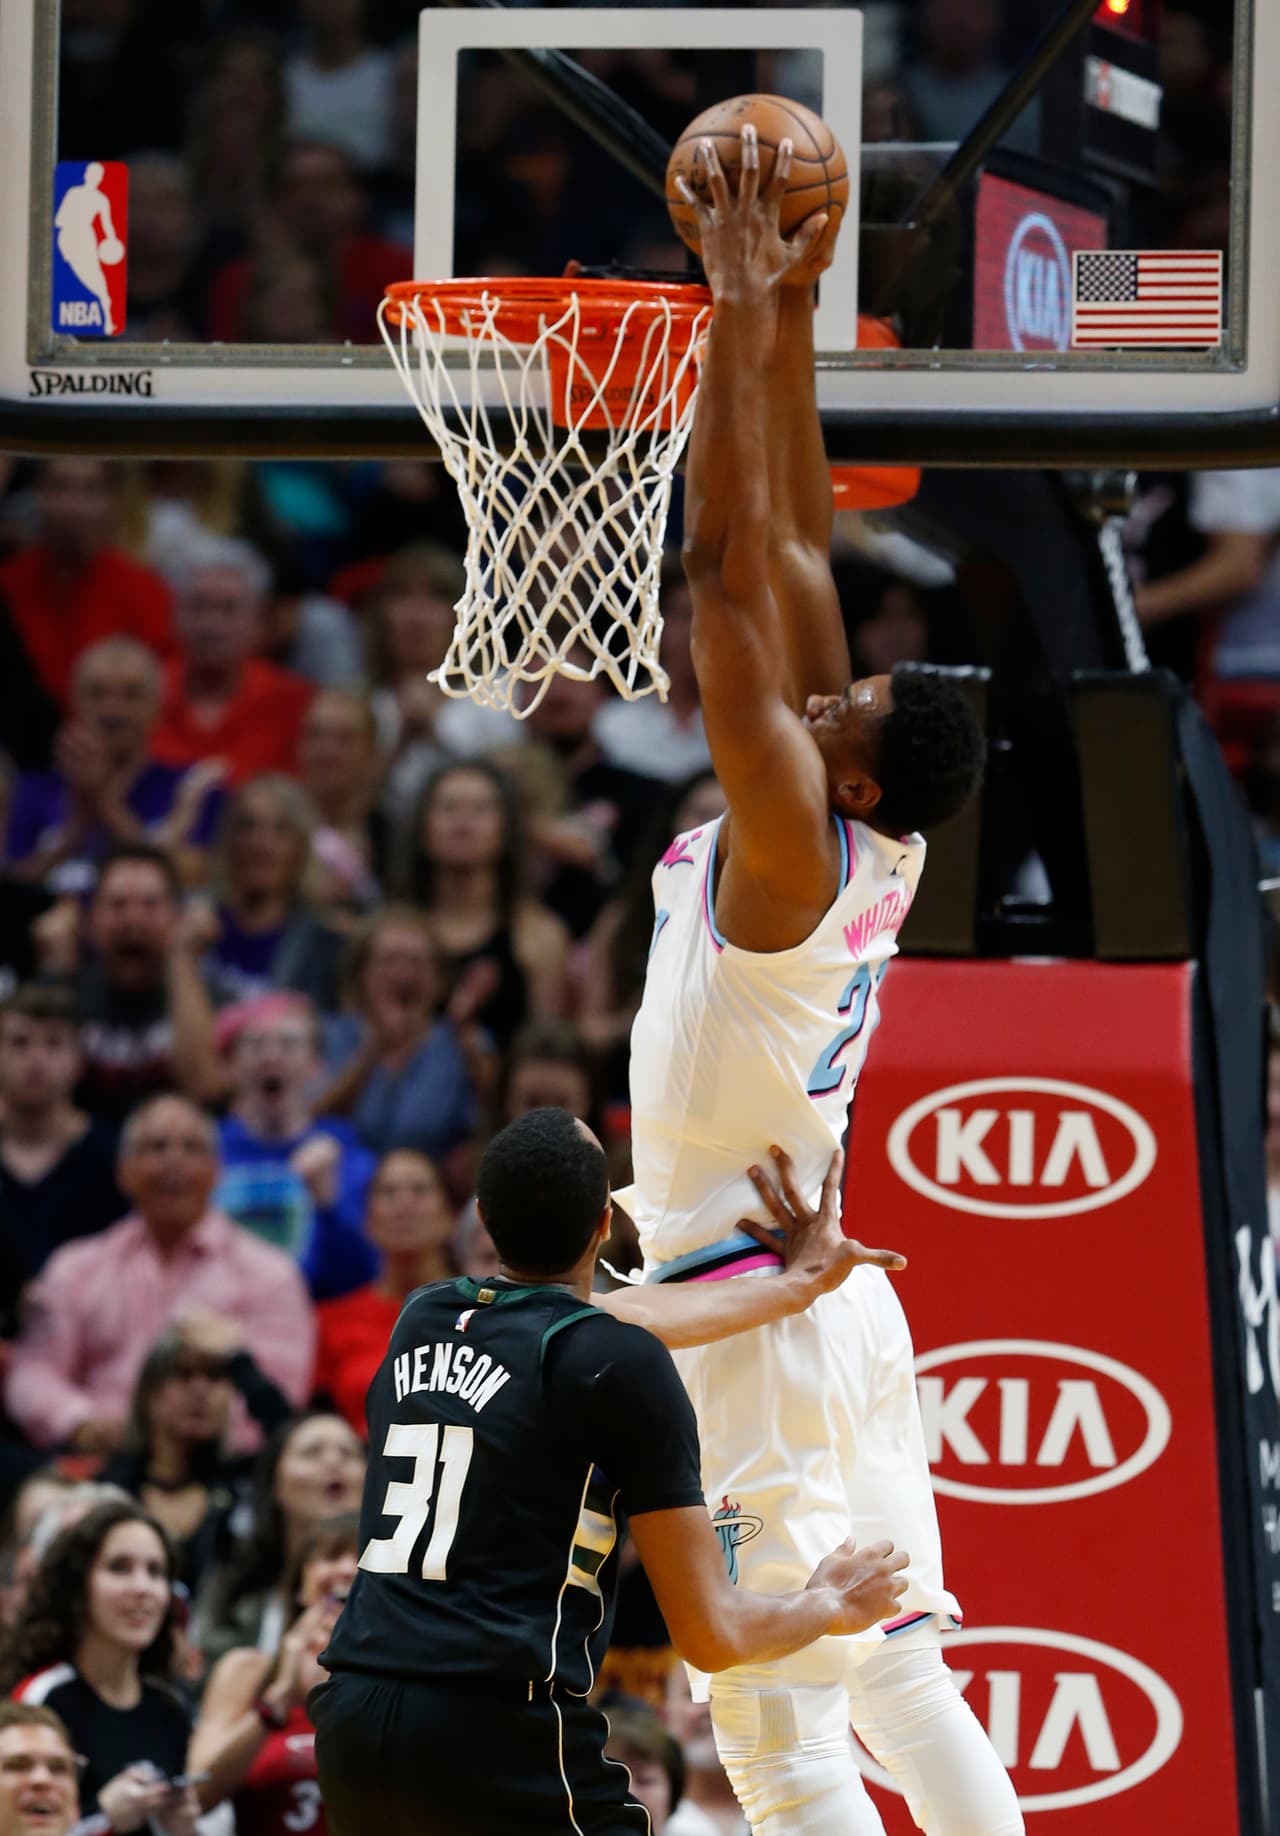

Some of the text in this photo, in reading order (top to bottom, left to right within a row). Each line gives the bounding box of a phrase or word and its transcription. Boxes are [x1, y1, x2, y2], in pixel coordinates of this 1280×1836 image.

[59, 301, 103, 326] NBA
[29, 370, 155, 397] SPALDING
[807, 959, 890, 1099] 2
[935, 1109, 1111, 1187] KIA
[393, 1342, 511, 1413] HENSON
[916, 1377, 1118, 1467] KIA
[357, 1423, 474, 1580] 31
[951, 1669, 1121, 1771] IA
